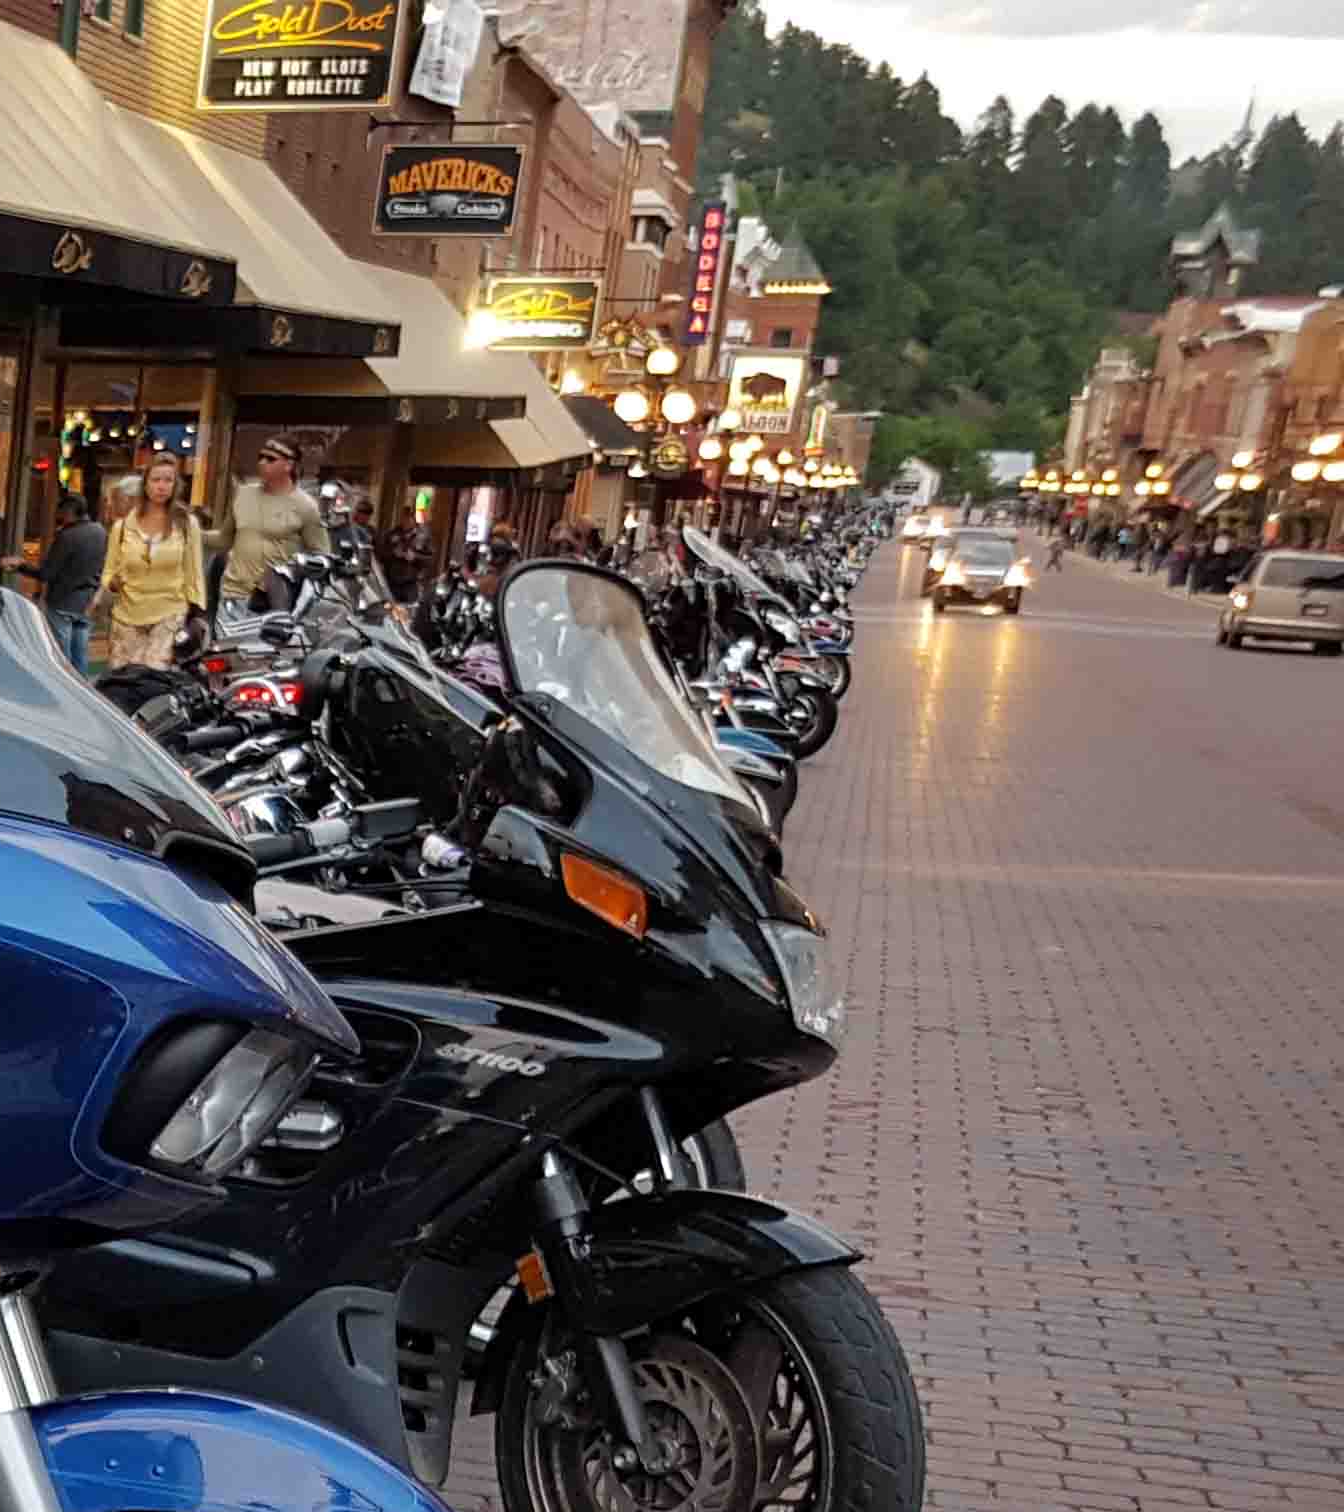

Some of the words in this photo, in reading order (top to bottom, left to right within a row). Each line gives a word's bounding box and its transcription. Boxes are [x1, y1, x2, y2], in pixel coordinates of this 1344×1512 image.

[320, 57, 370, 76] SLOTS
[286, 77, 363, 96] ROULETTE
[388, 157, 514, 197] MAVERICKS
[687, 207, 725, 334] BODEGA
[434, 1042, 547, 1077] ST1100
